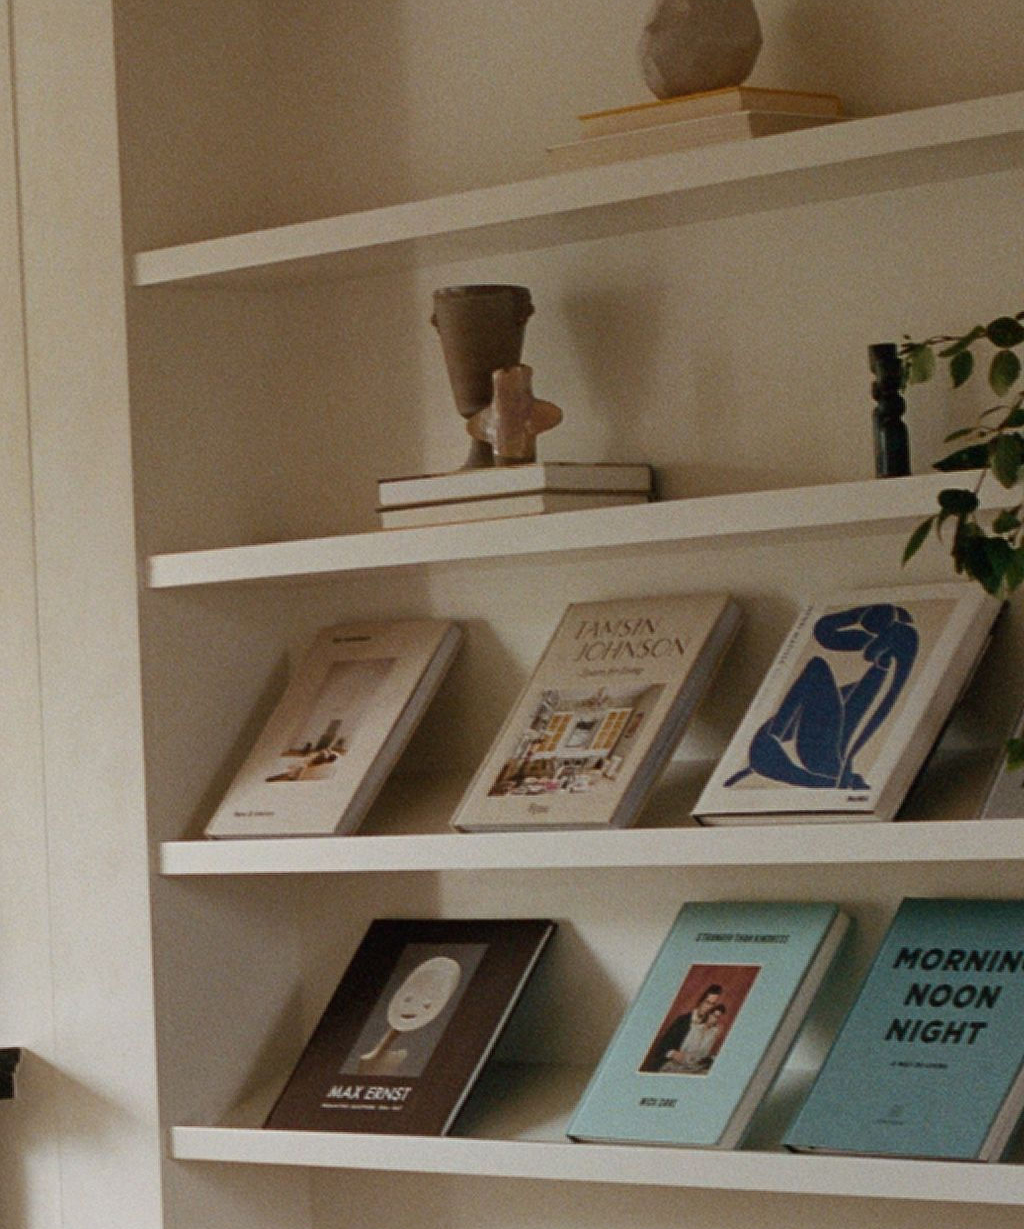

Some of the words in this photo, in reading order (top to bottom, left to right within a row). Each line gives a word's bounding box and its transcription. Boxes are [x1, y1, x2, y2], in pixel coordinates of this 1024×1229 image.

[575, 618, 660, 640] TAMSIN
[573, 637, 691, 662] JOHNSON
[892, 947, 1024, 973] MORNIN
[902, 982, 1003, 1009] NOON
[884, 1018, 988, 1045] NIGHT
[326, 1085, 364, 1099] MAX
[363, 1086, 413, 1101] ERNST
